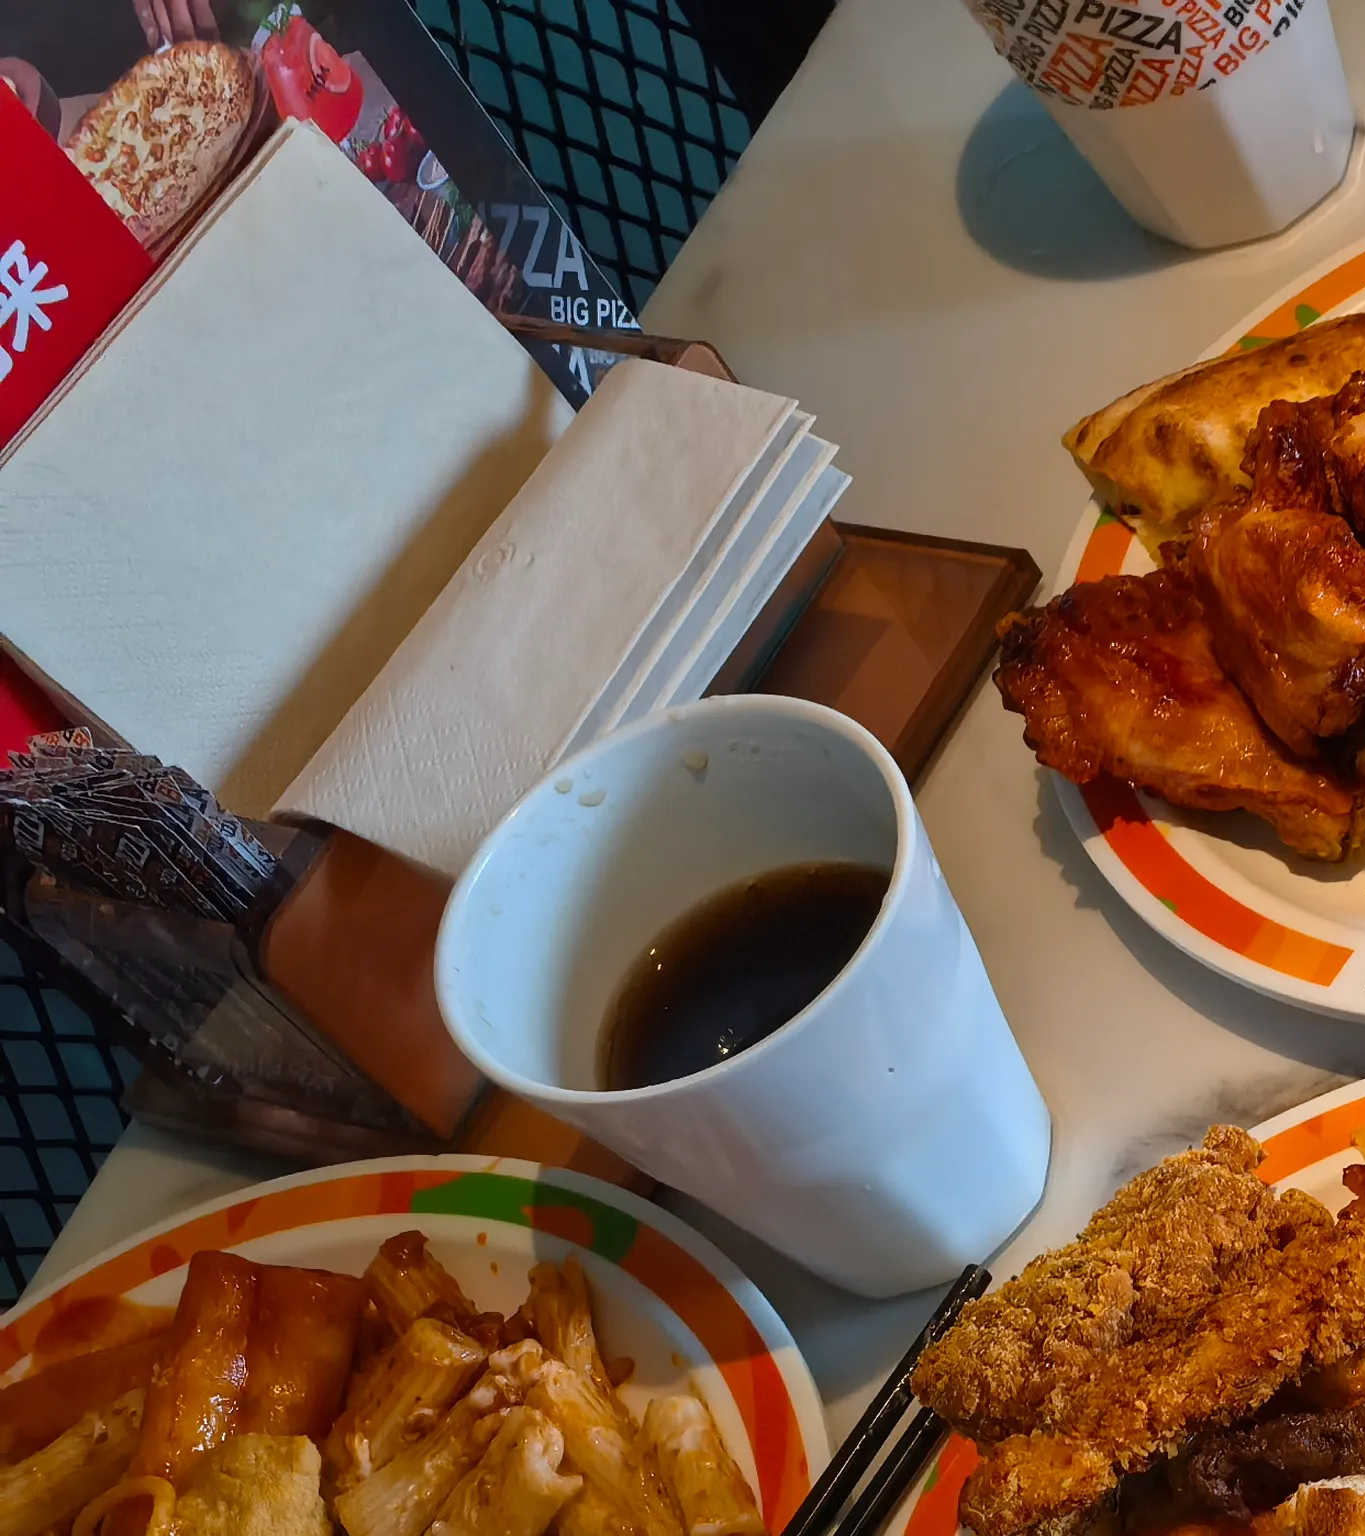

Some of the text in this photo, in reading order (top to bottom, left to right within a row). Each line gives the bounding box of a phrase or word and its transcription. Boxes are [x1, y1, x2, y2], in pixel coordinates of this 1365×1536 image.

[1073, 0, 1182, 54] PIZZA
[1213, 26, 1262, 77] BIG
[550, 295, 590, 327] BIG
